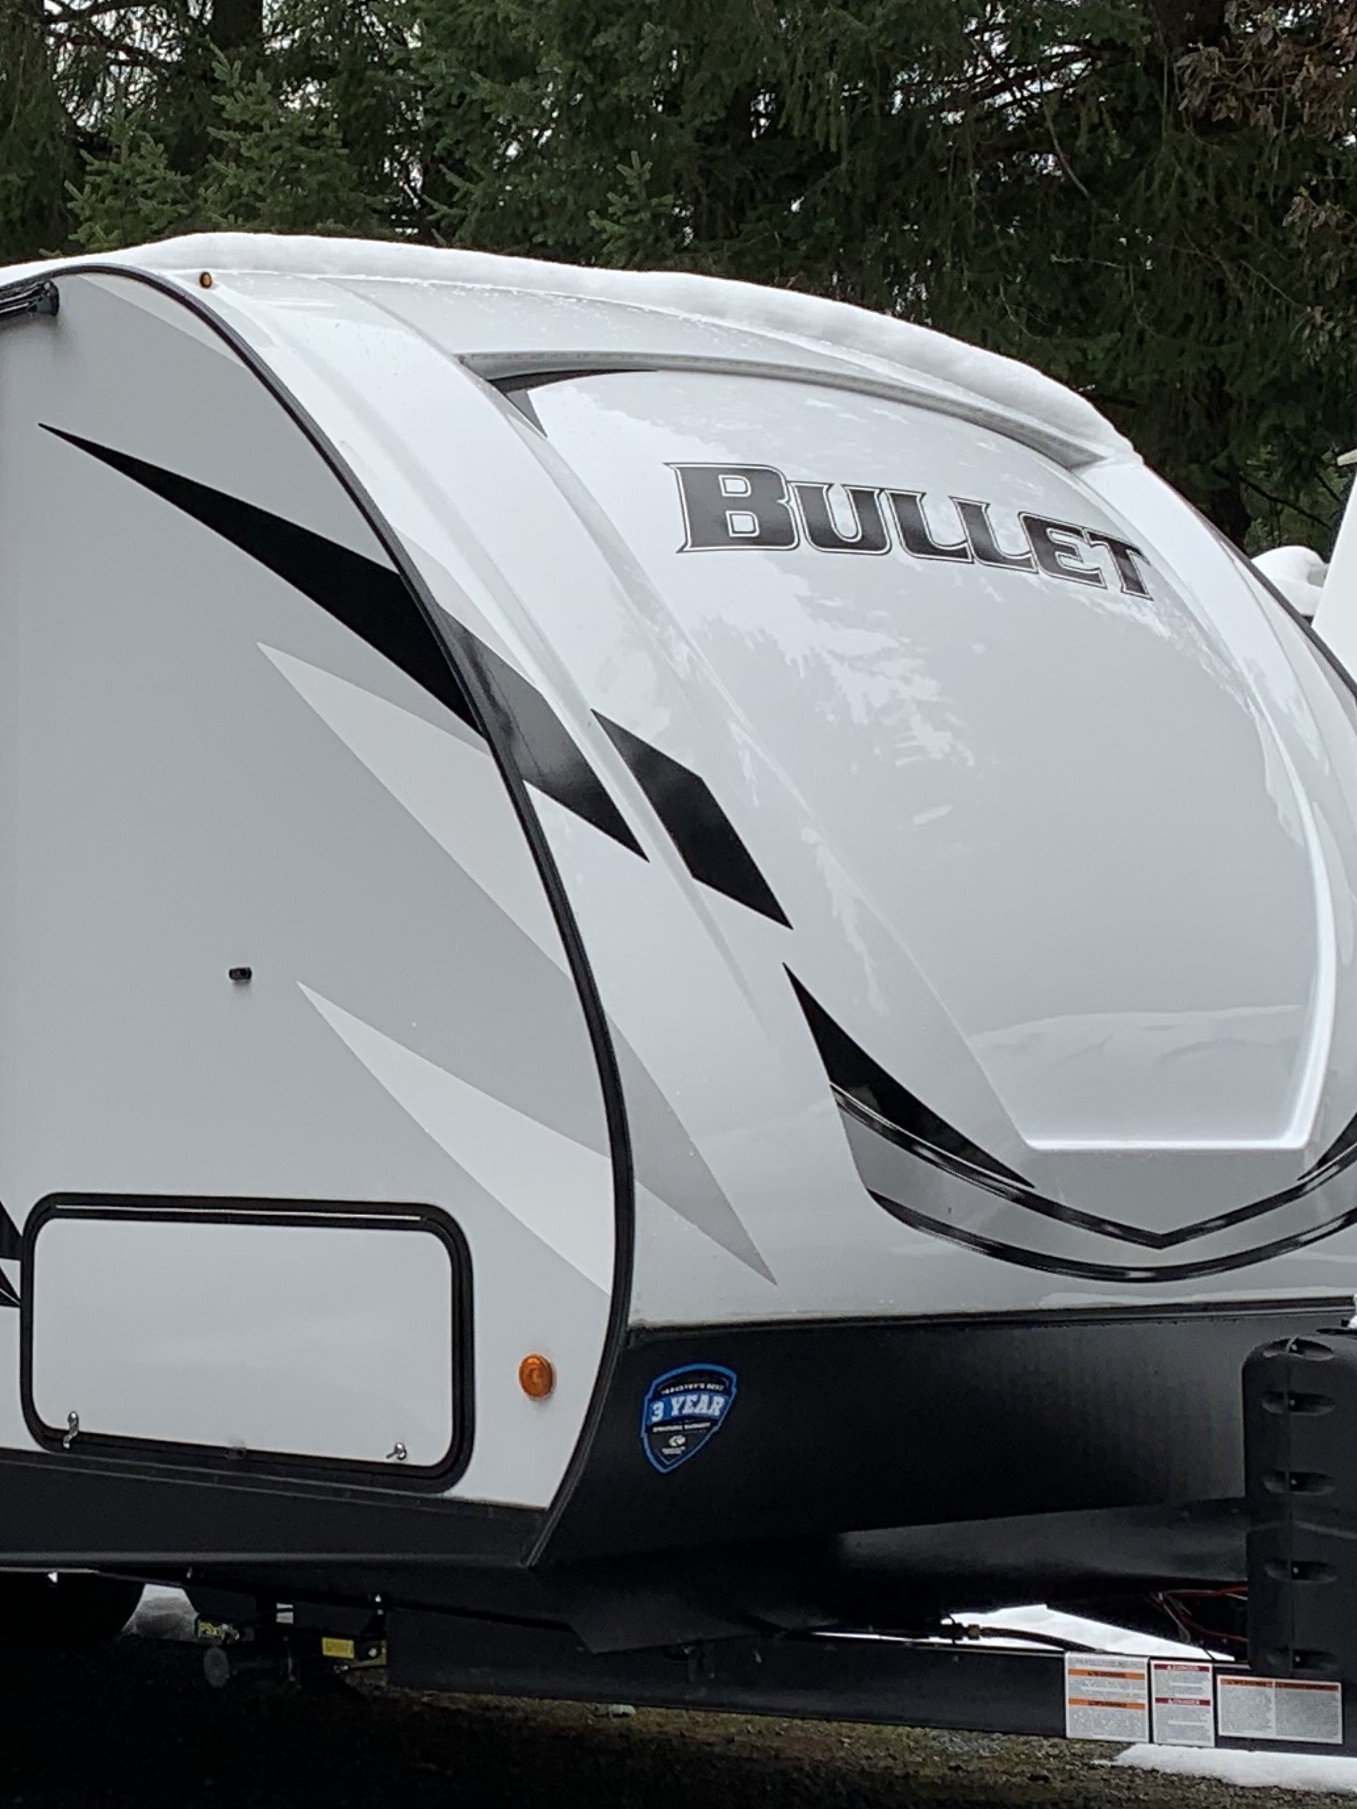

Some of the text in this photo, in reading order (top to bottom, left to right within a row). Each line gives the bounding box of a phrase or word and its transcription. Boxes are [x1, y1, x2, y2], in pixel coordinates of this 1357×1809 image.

[664, 462, 1154, 601] BULLET
[651, 1395, 725, 1422] 3 YEAR
